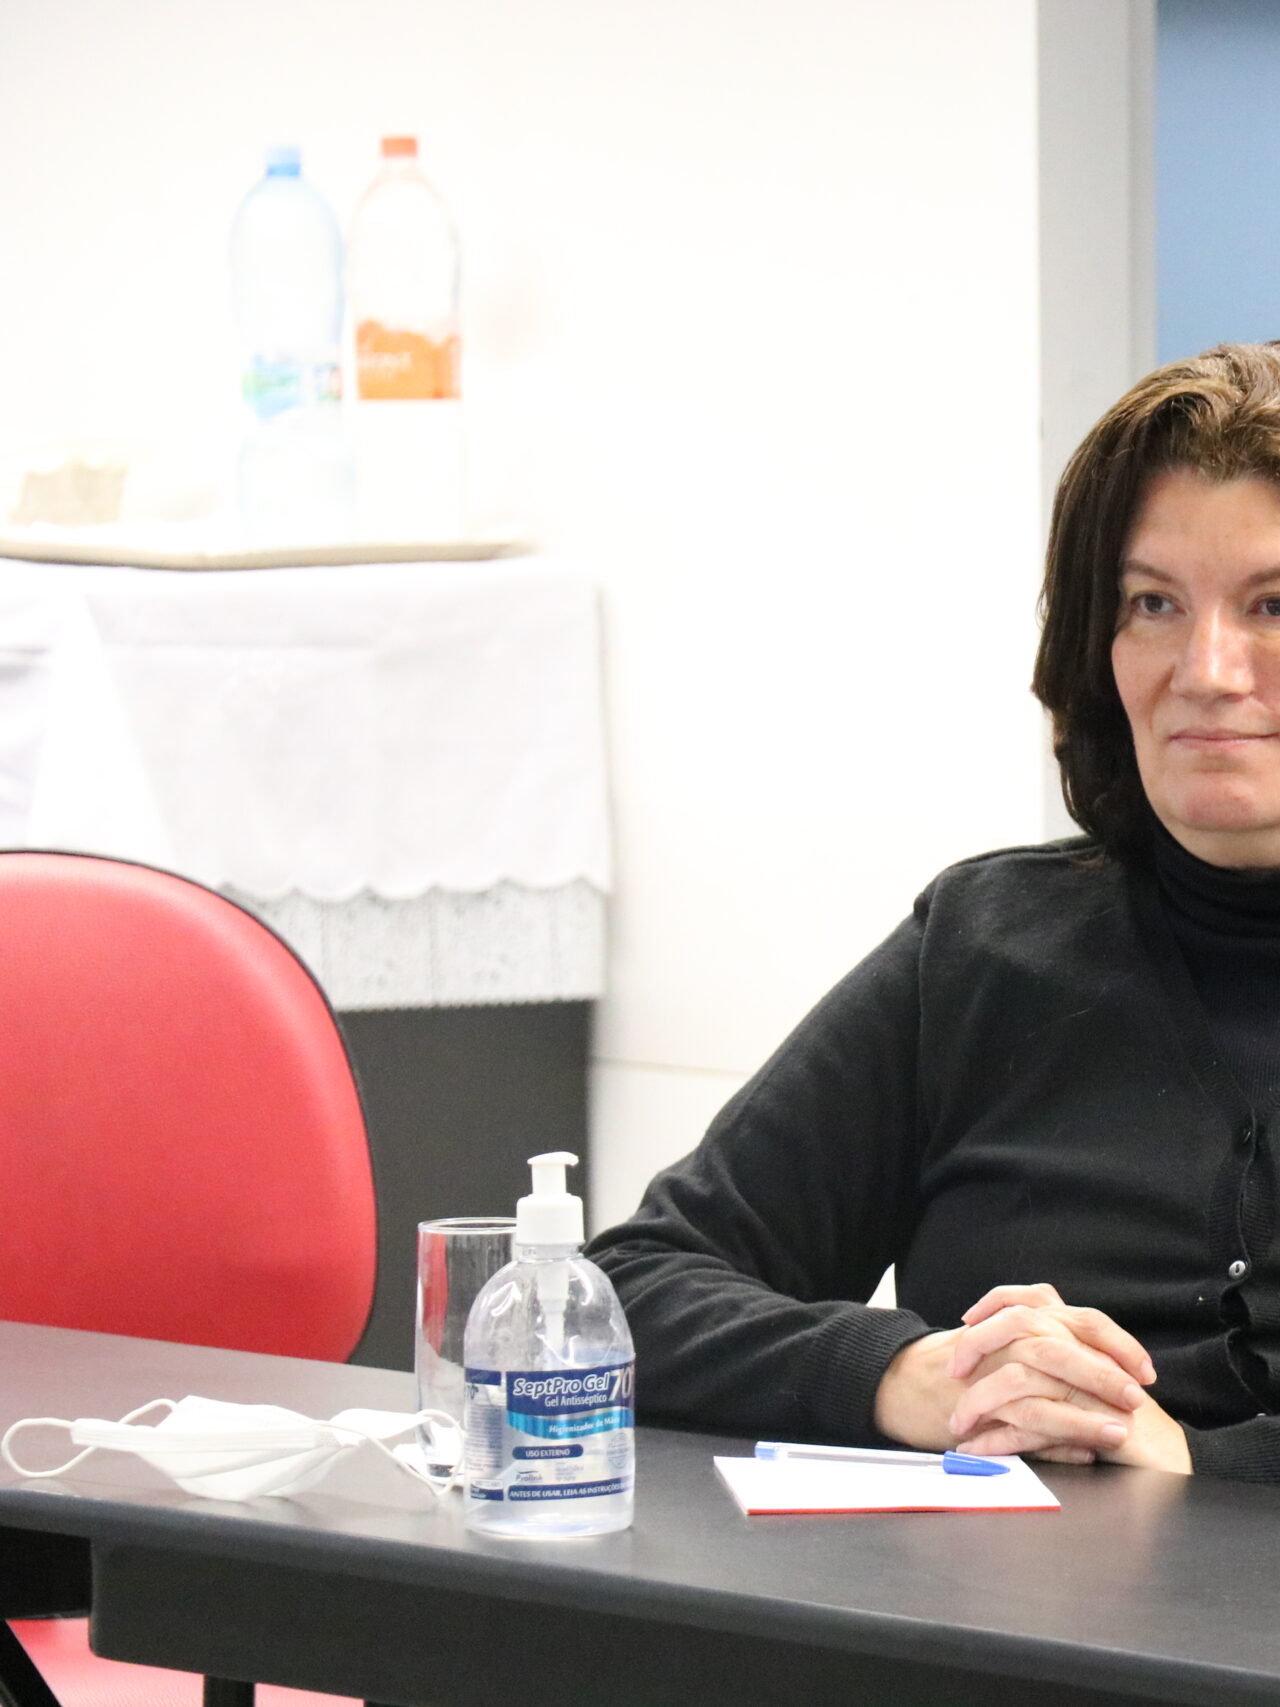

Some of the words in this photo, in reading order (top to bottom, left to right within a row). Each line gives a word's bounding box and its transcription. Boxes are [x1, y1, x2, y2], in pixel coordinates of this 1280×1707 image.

[513, 1376, 581, 1399] SeptPro
[583, 1371, 610, 1392] Gel
[544, 1396, 559, 1407] Gel
[560, 1393, 607, 1407] Antisséptico
[525, 1449, 540, 1458] USO
[541, 1448, 571, 1457] EXTERNO
[509, 1489, 531, 1498] ANTES
[532, 1489, 541, 1498] DE
[563, 1487, 578, 1496] LEIA
[578, 1487, 587, 1495] AS
